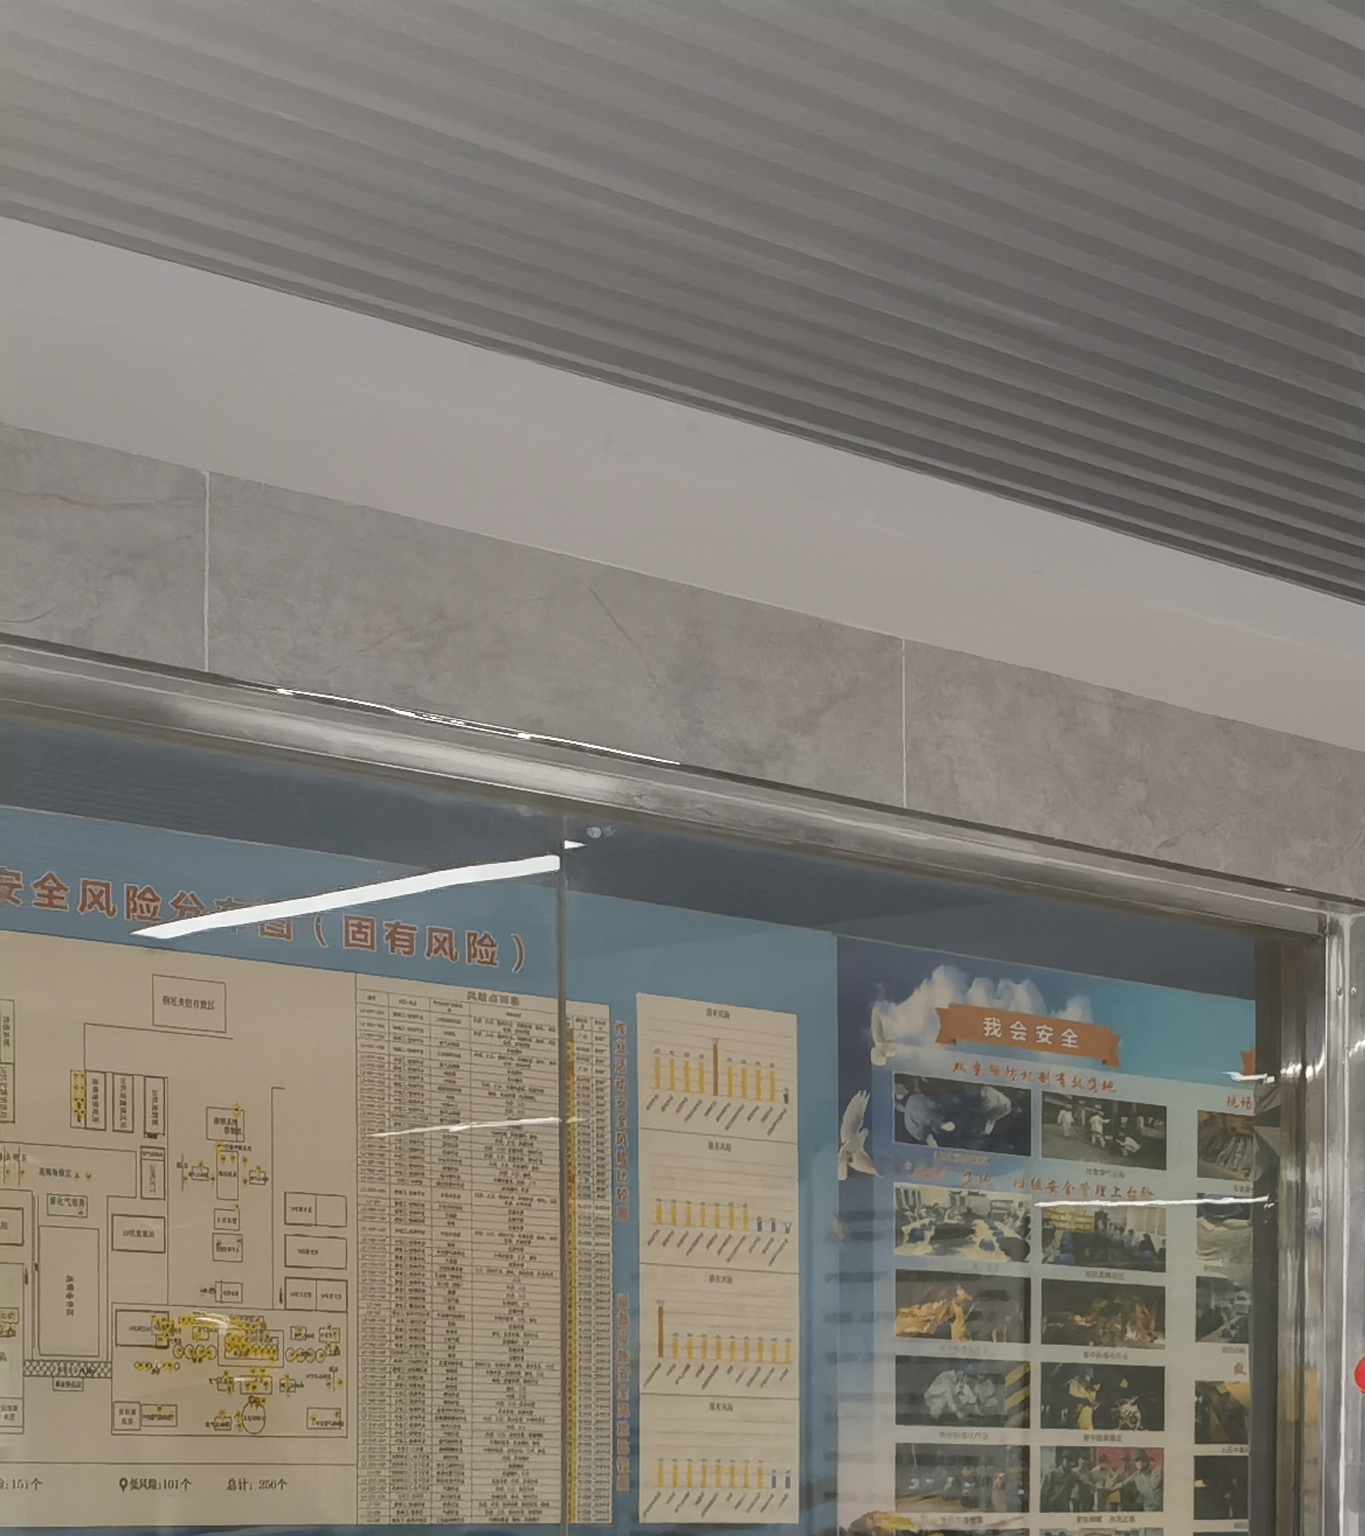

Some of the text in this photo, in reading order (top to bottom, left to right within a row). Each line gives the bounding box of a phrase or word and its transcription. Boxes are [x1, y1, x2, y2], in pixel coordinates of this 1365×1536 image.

[0, 866, 525, 973] 安全风险分图（固有风险）
[982, 1016, 1080, 1049] 我会安全
